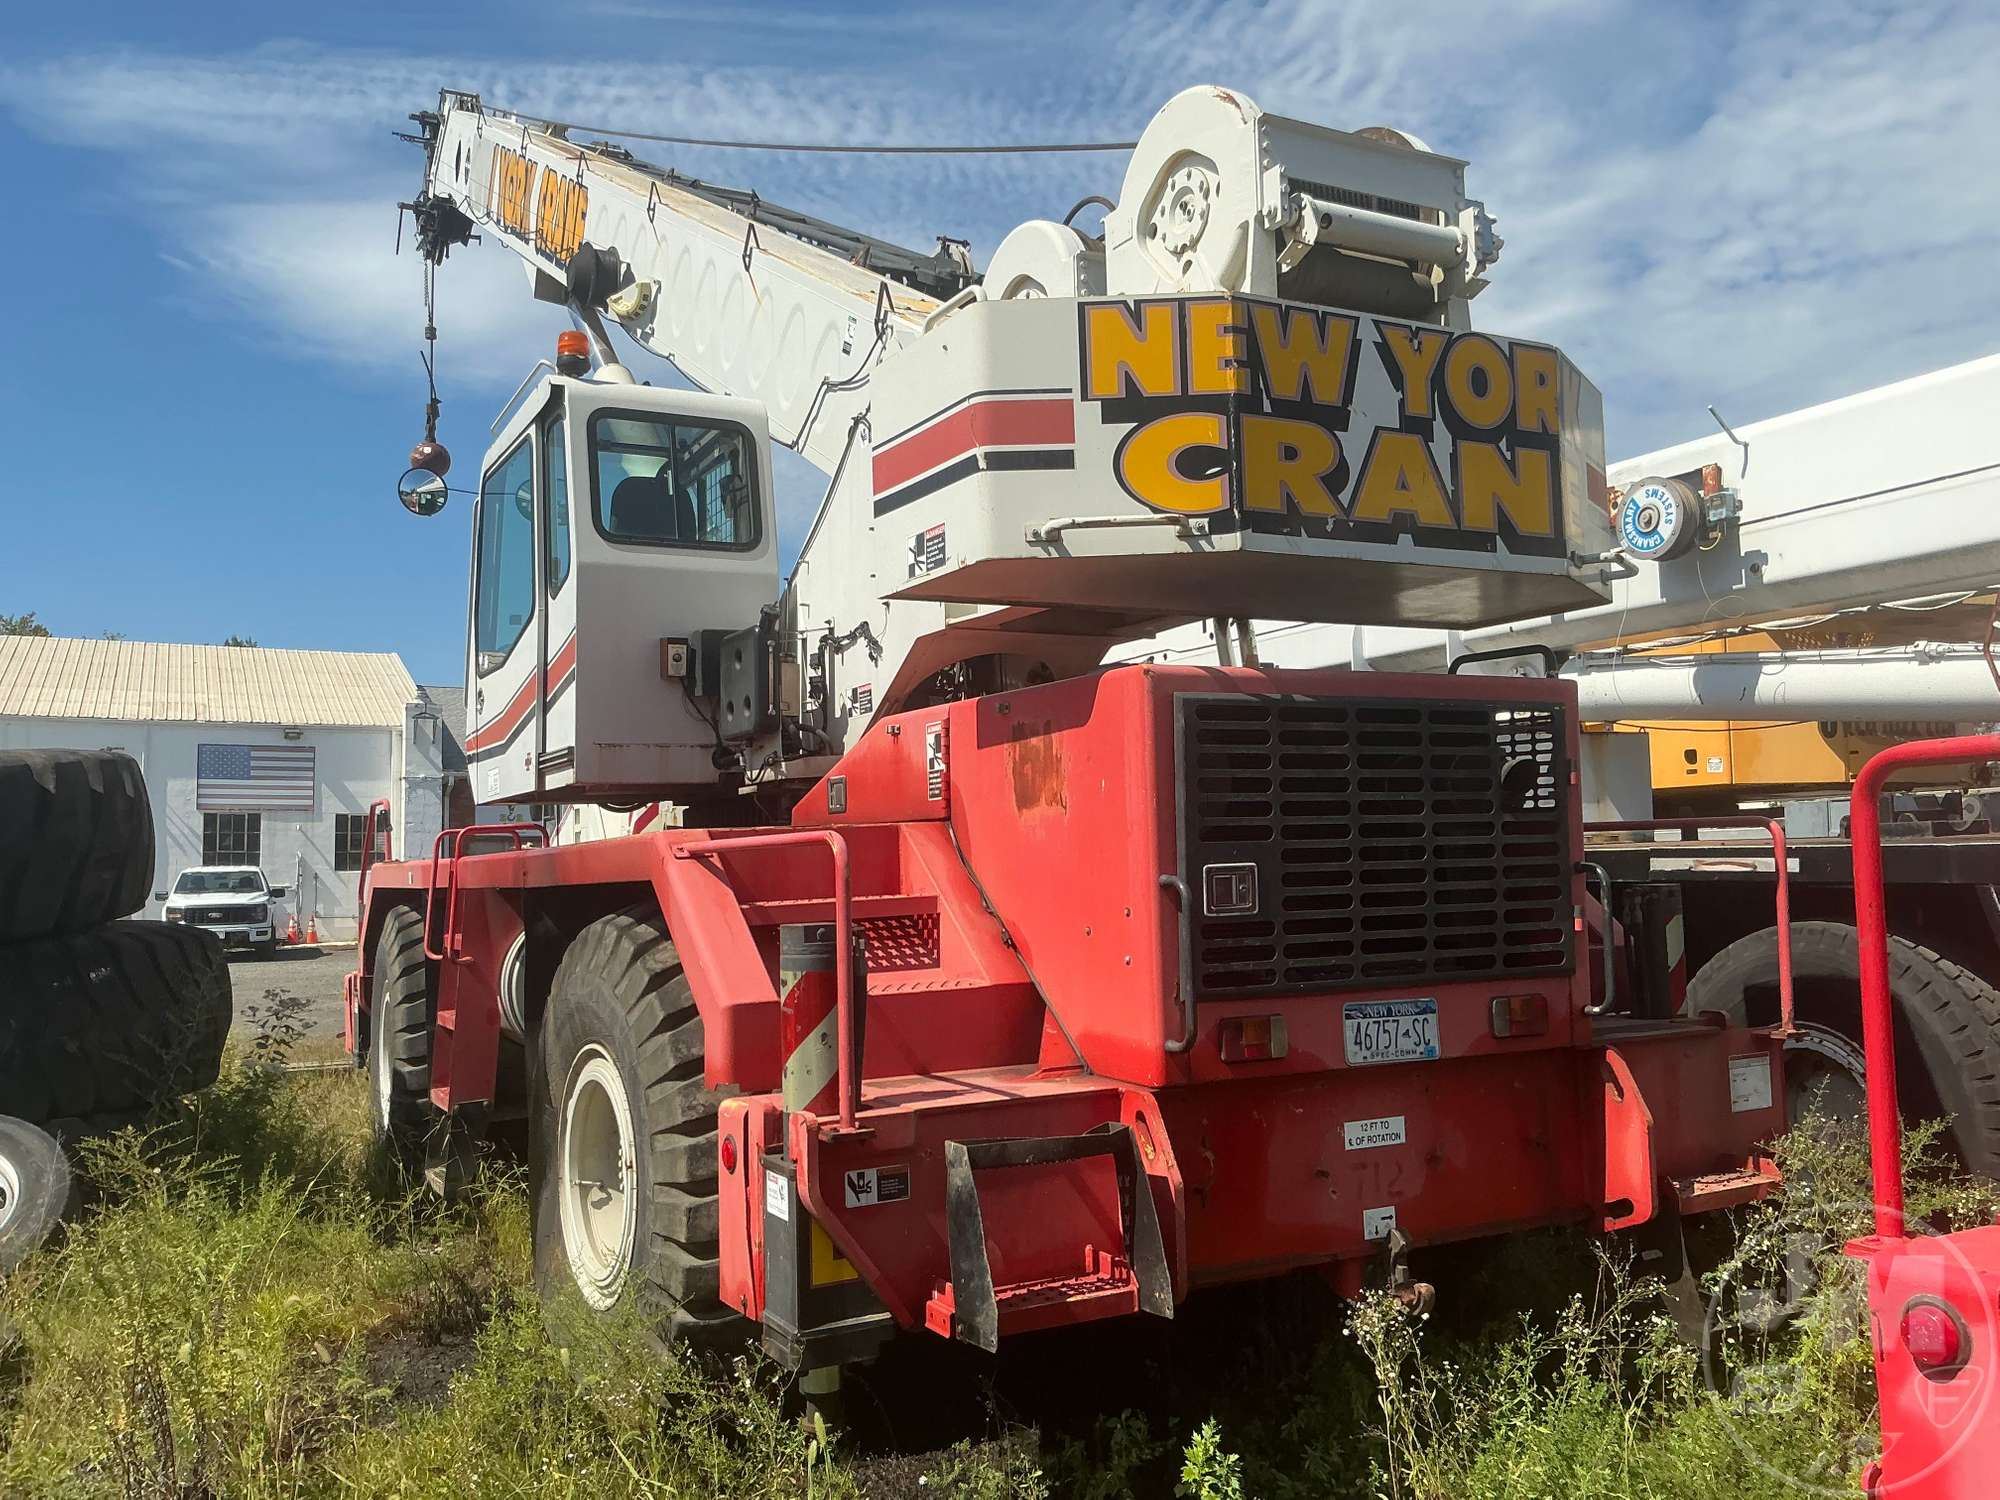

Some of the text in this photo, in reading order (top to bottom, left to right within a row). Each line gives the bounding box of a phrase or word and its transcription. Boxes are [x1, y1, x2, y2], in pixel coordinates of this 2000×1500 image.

[1078, 297, 1361, 407] NEW
[1644, 487, 1674, 526] SYSTEMS
[1623, 501, 1662, 549] CRANESMART
[1366, 1003, 1416, 1018] NEW YORK
[1355, 1135, 1366, 1146] OF
[1367, 1132, 1401, 1144] ROTATION
[1360, 1120, 1390, 1133] 12 FT TO
